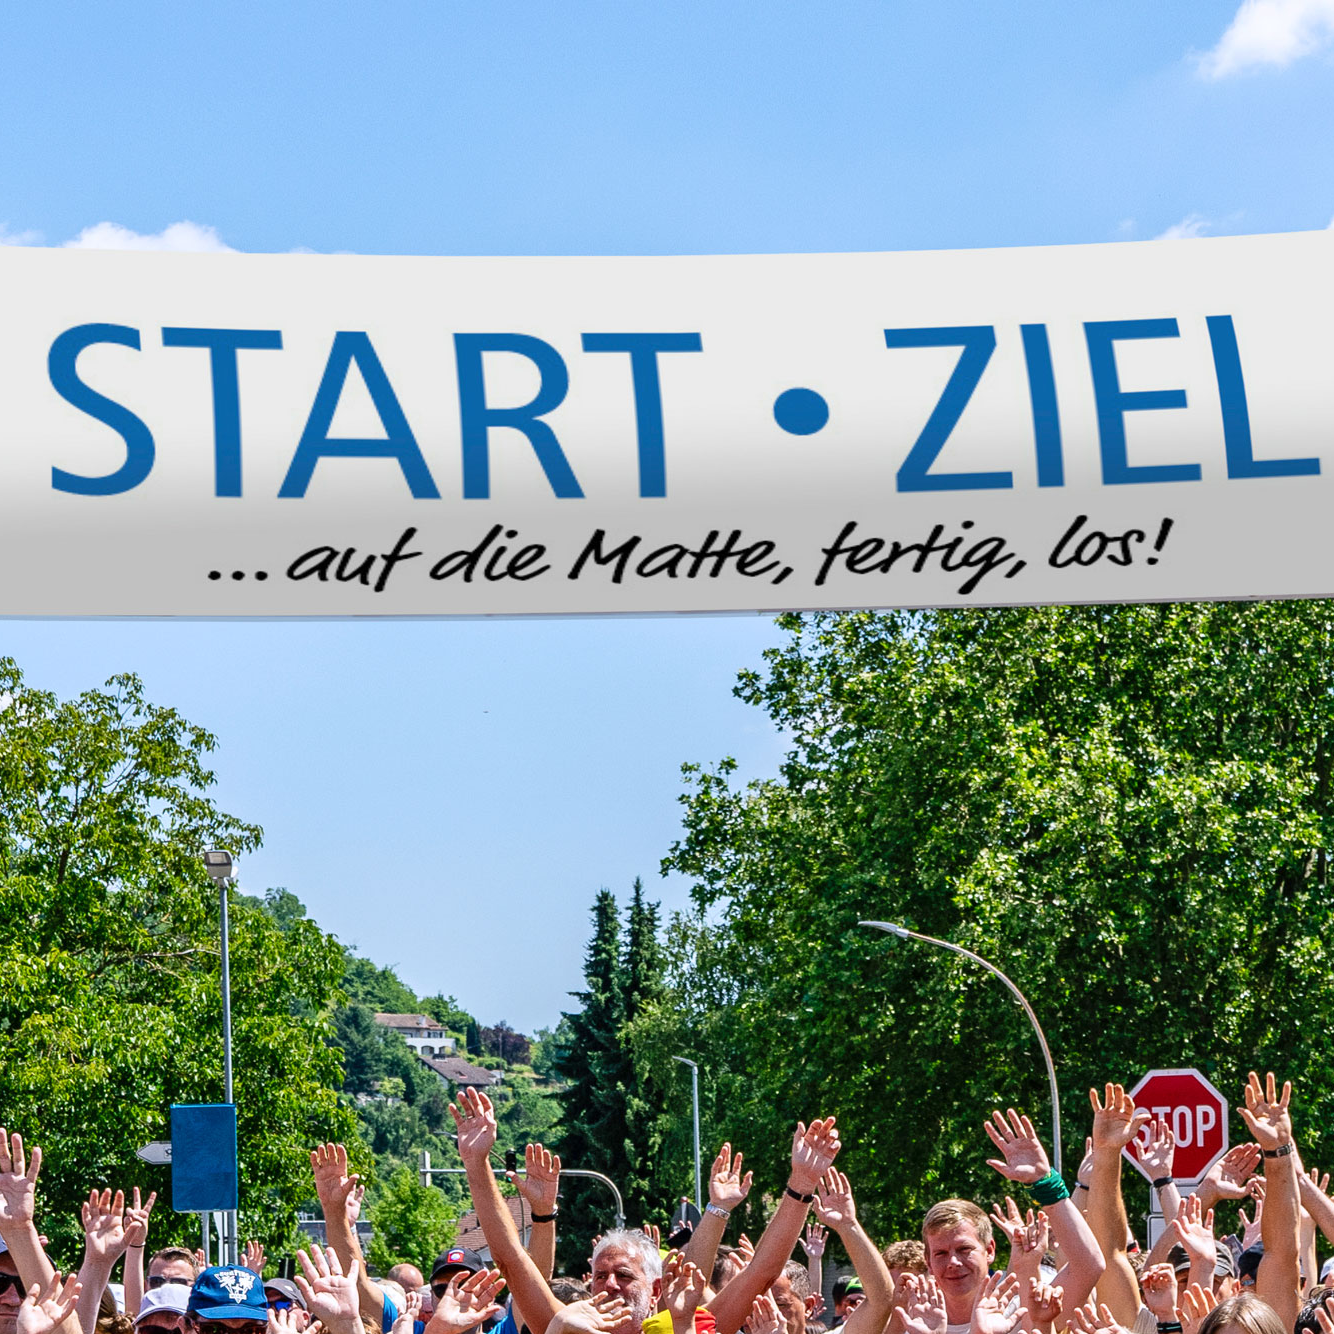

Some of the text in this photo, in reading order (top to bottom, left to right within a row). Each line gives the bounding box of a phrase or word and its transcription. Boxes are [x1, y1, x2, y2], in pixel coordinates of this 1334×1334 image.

[48, 322, 702, 500] START
[883, 315, 1321, 493] ZIEL
[287, 526, 423, 593] auf
[430, 523, 551, 583] die
[567, 528, 795, 585] Matte,
[814, 520, 1028, 595] fertig,
[1048, 514, 1174, 569] los!
[1131, 1104, 1216, 1149] STOP
